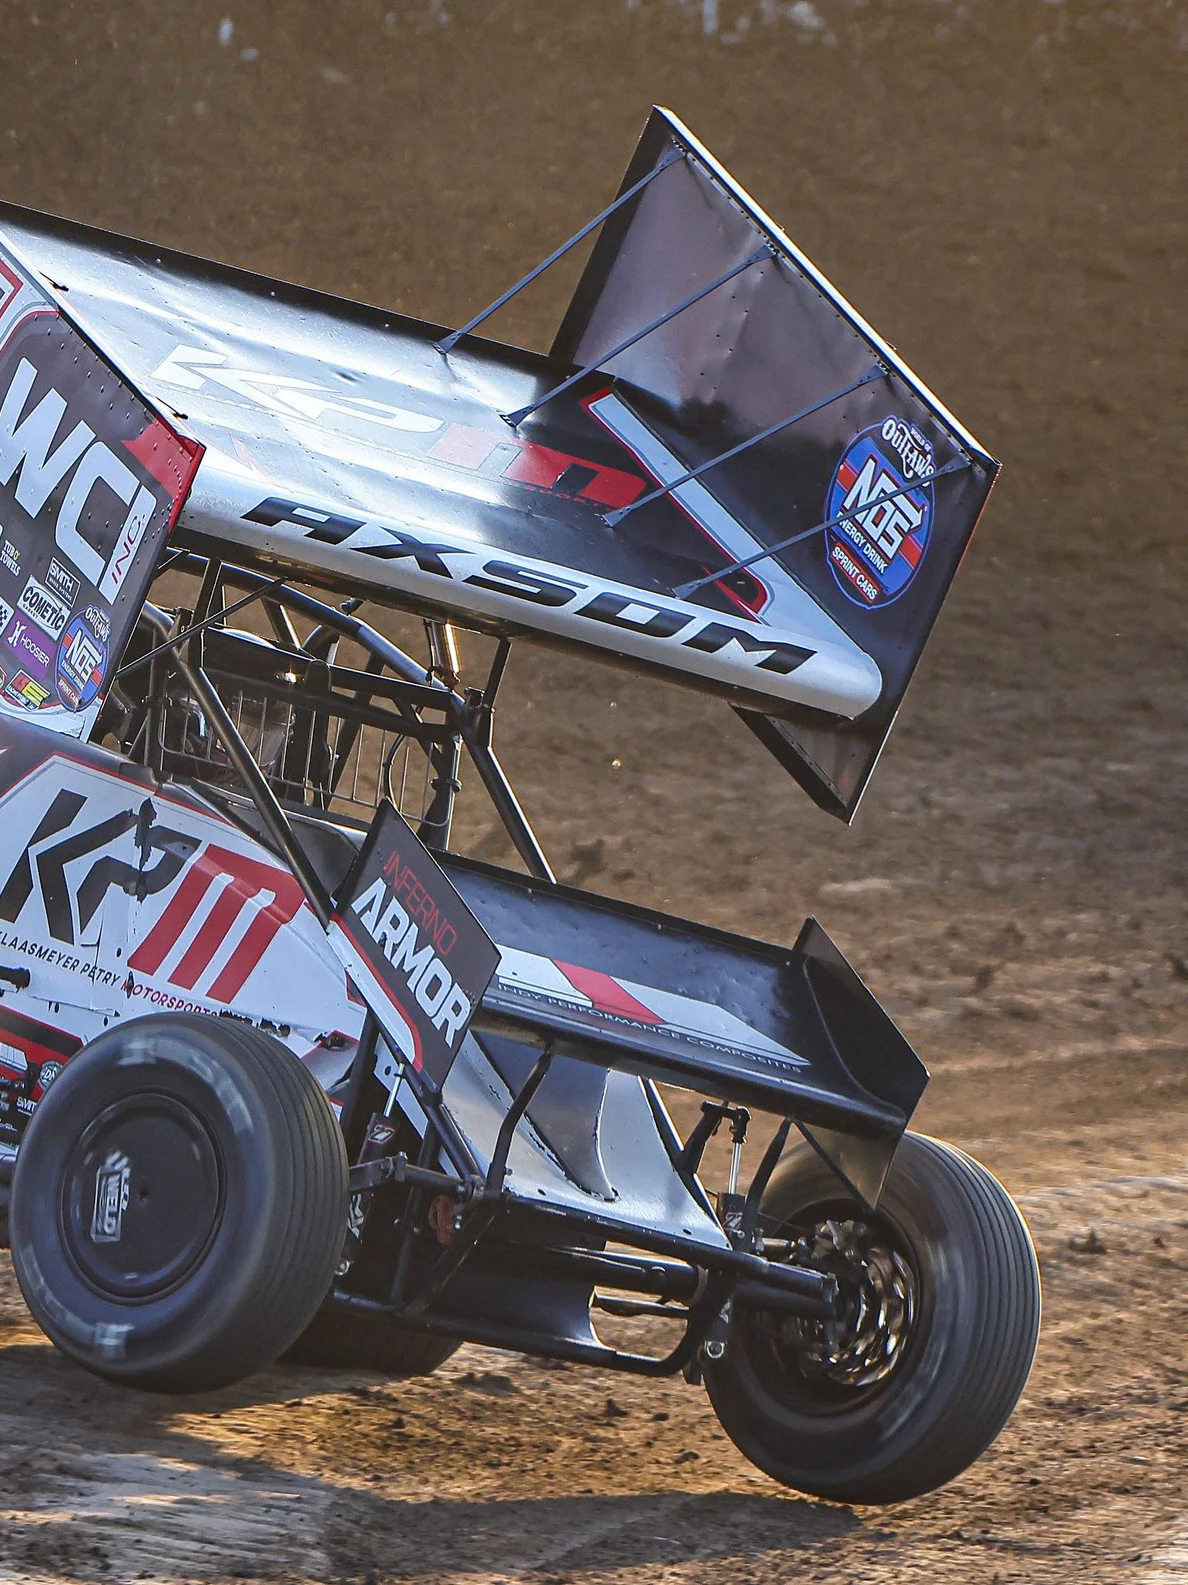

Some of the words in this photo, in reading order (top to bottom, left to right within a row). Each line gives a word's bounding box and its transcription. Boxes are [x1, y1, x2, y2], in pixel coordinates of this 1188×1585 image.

[843, 458, 923, 559] NOS
[0, 550, 21, 577] TOWELS
[49, 562, 75, 592] SMITH
[832, 546, 860, 578] SPRINT
[856, 572, 878, 600] CARS
[863, 543, 888, 574] DRINK
[242, 497, 817, 673] AXSOM
[22, 586, 65, 631] COMETIC
[19, 633, 50, 667] HOOSIER
[65, 629, 103, 682] NOS
[383, 850, 457, 956] INFERNO
[80, 962, 121, 987] PETRY
[351, 877, 471, 1048] ARMOR
[498, 984, 541, 1001] INDY
[548, 998, 680, 1040] PERFORMANCE
[686, 1036, 802, 1074] COMPOSITES
[16, 1096, 37, 1112] SMIT
[369, 1125, 394, 1143] 27
